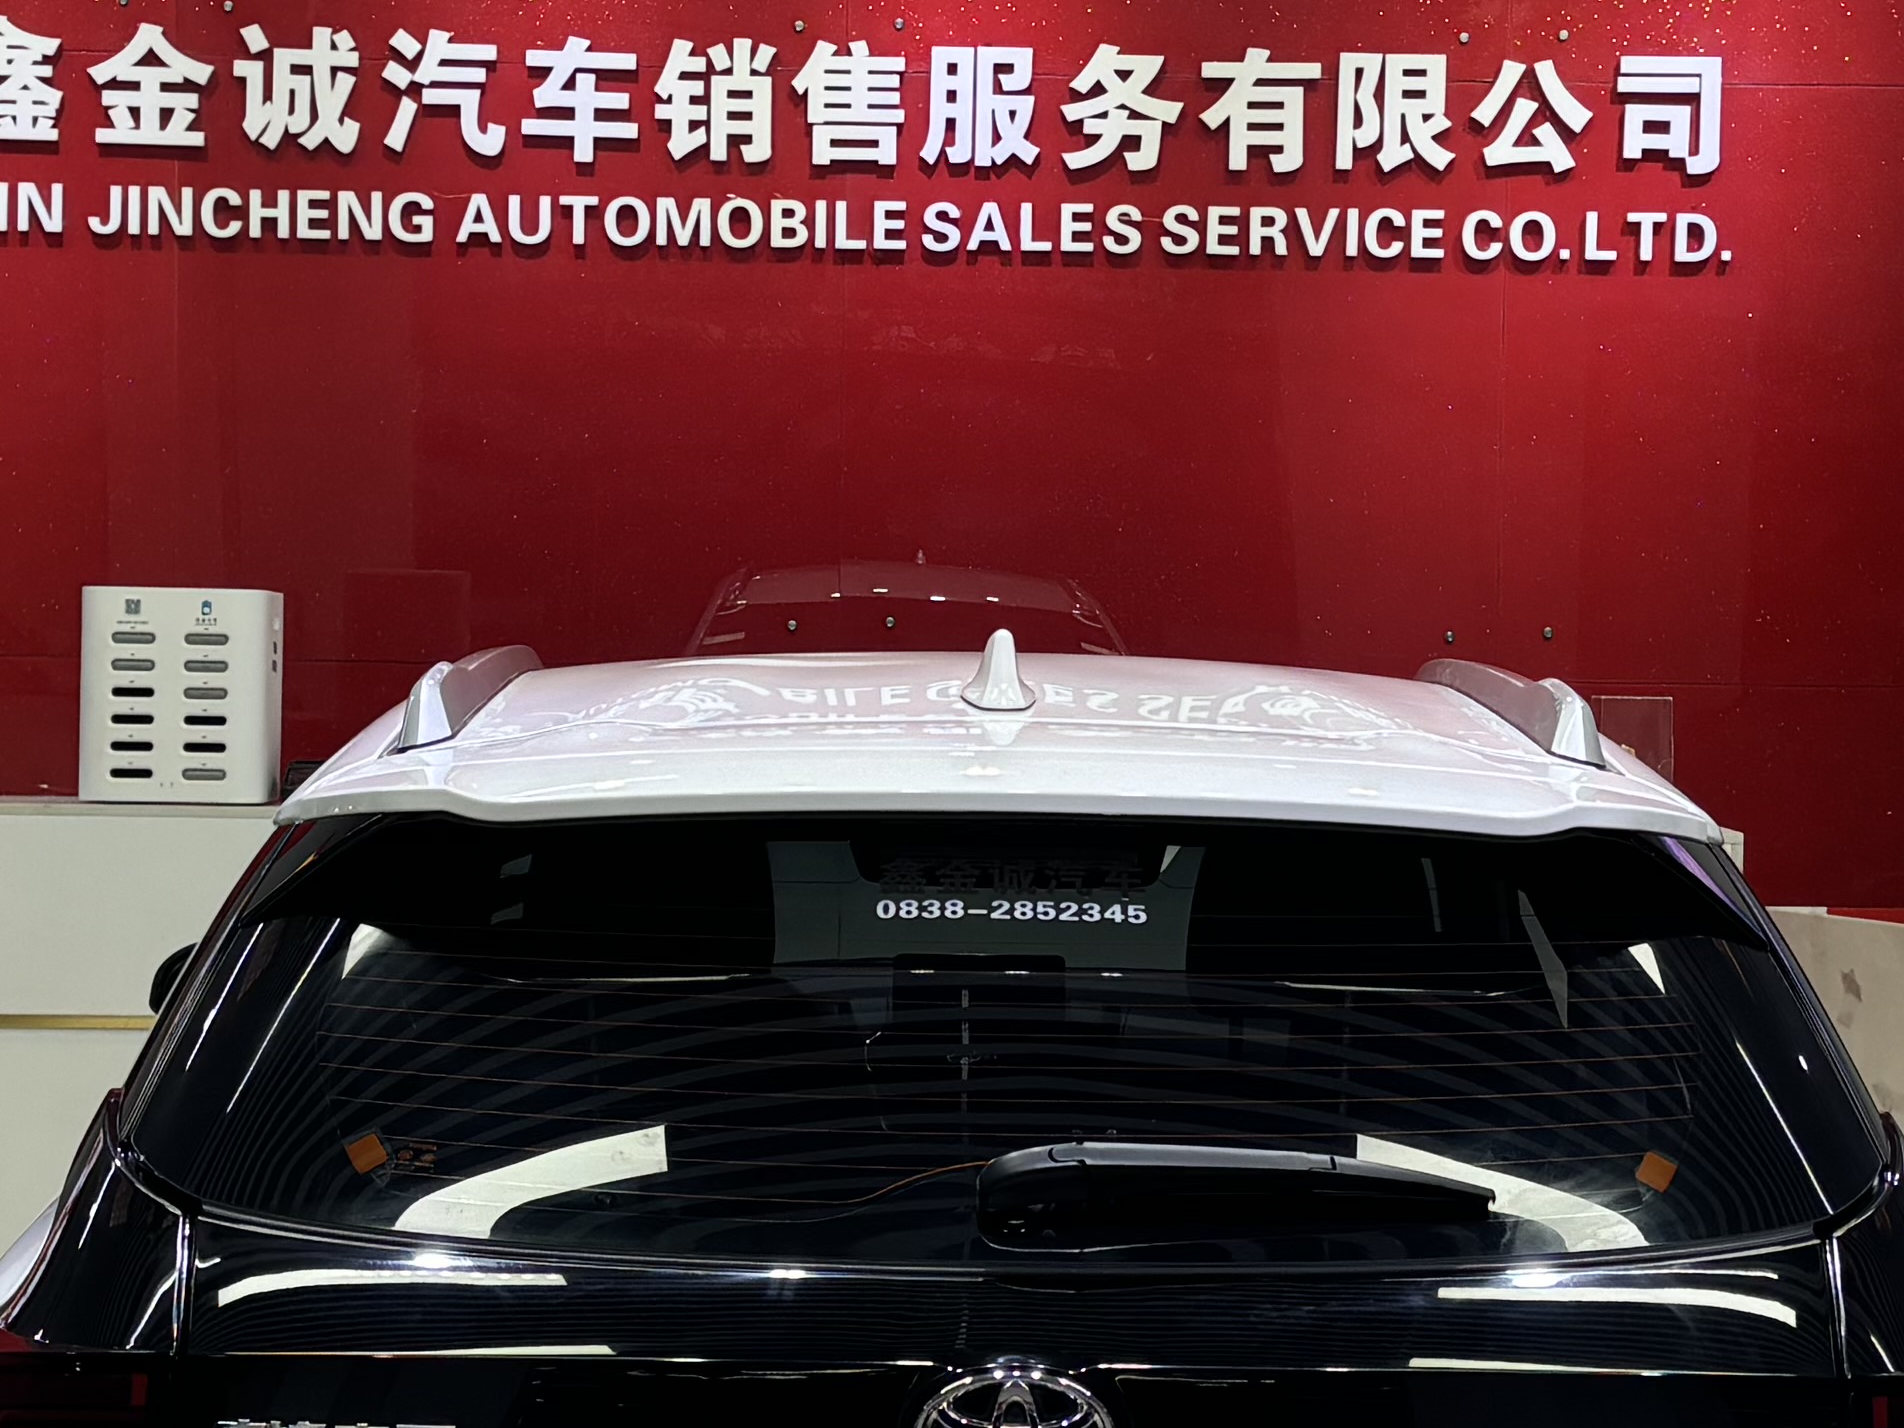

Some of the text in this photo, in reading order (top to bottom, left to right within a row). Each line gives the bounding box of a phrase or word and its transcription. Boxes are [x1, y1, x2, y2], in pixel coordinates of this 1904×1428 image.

[87, 184, 434, 243] JINCHENG
[455, 193, 907, 249] AUTOMOBILE
[921, 201, 1142, 256] SALES
[1160, 205, 1445, 261] SERVICE
[875, 898, 1148, 925] 0838-2852345
